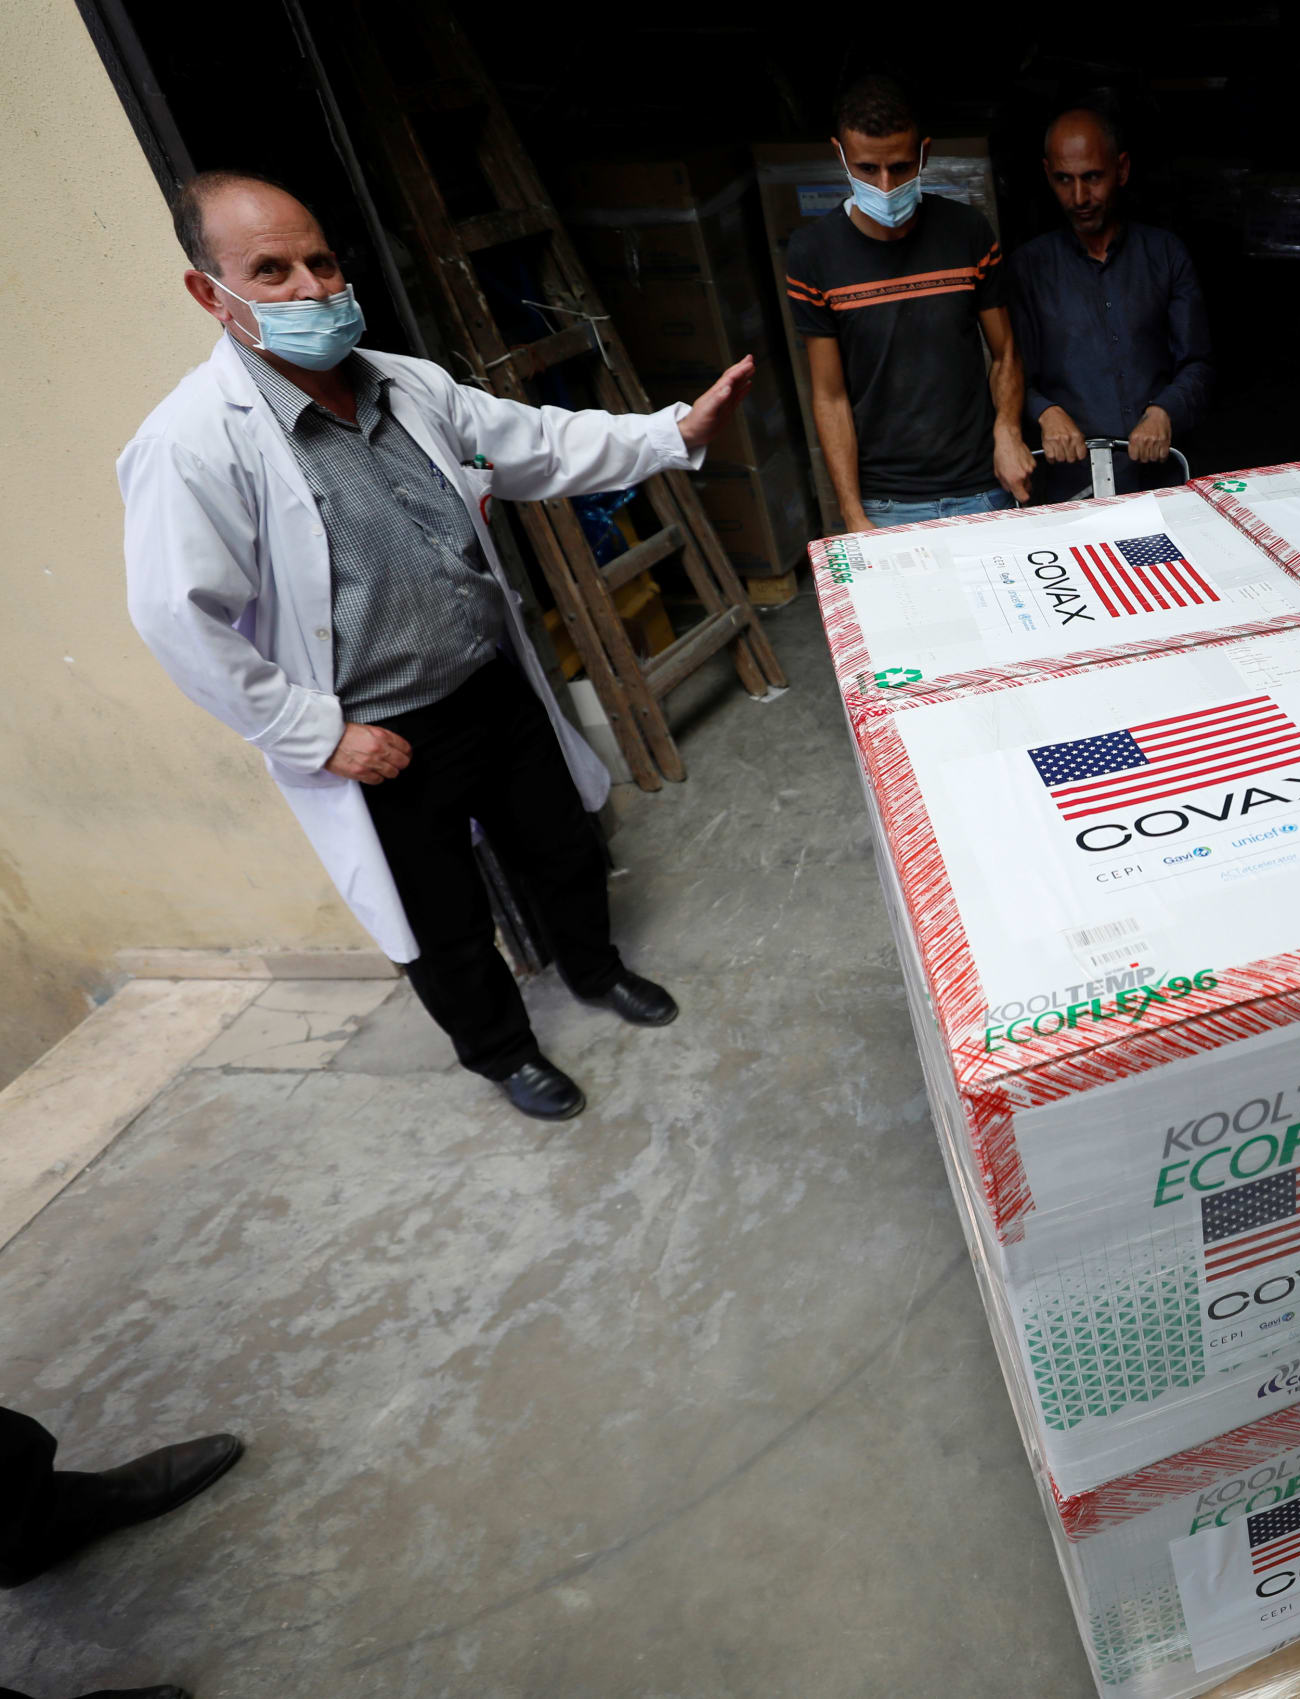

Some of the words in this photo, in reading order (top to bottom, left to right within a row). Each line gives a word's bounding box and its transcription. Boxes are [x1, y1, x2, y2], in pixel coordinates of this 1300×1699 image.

[1027, 550, 1096, 625] COVAX
[1096, 864, 1142, 883] CEPI
[1163, 851, 1194, 865] Gavi
[1232, 826, 1279, 848] unicef
[984, 967, 1156, 1026] KOOLTEMP
[1209, 1330, 1244, 1348] CEPI
[1259, 1317, 1282, 1331] Gavi
[1260, 1603, 1293, 1622] CEPI
